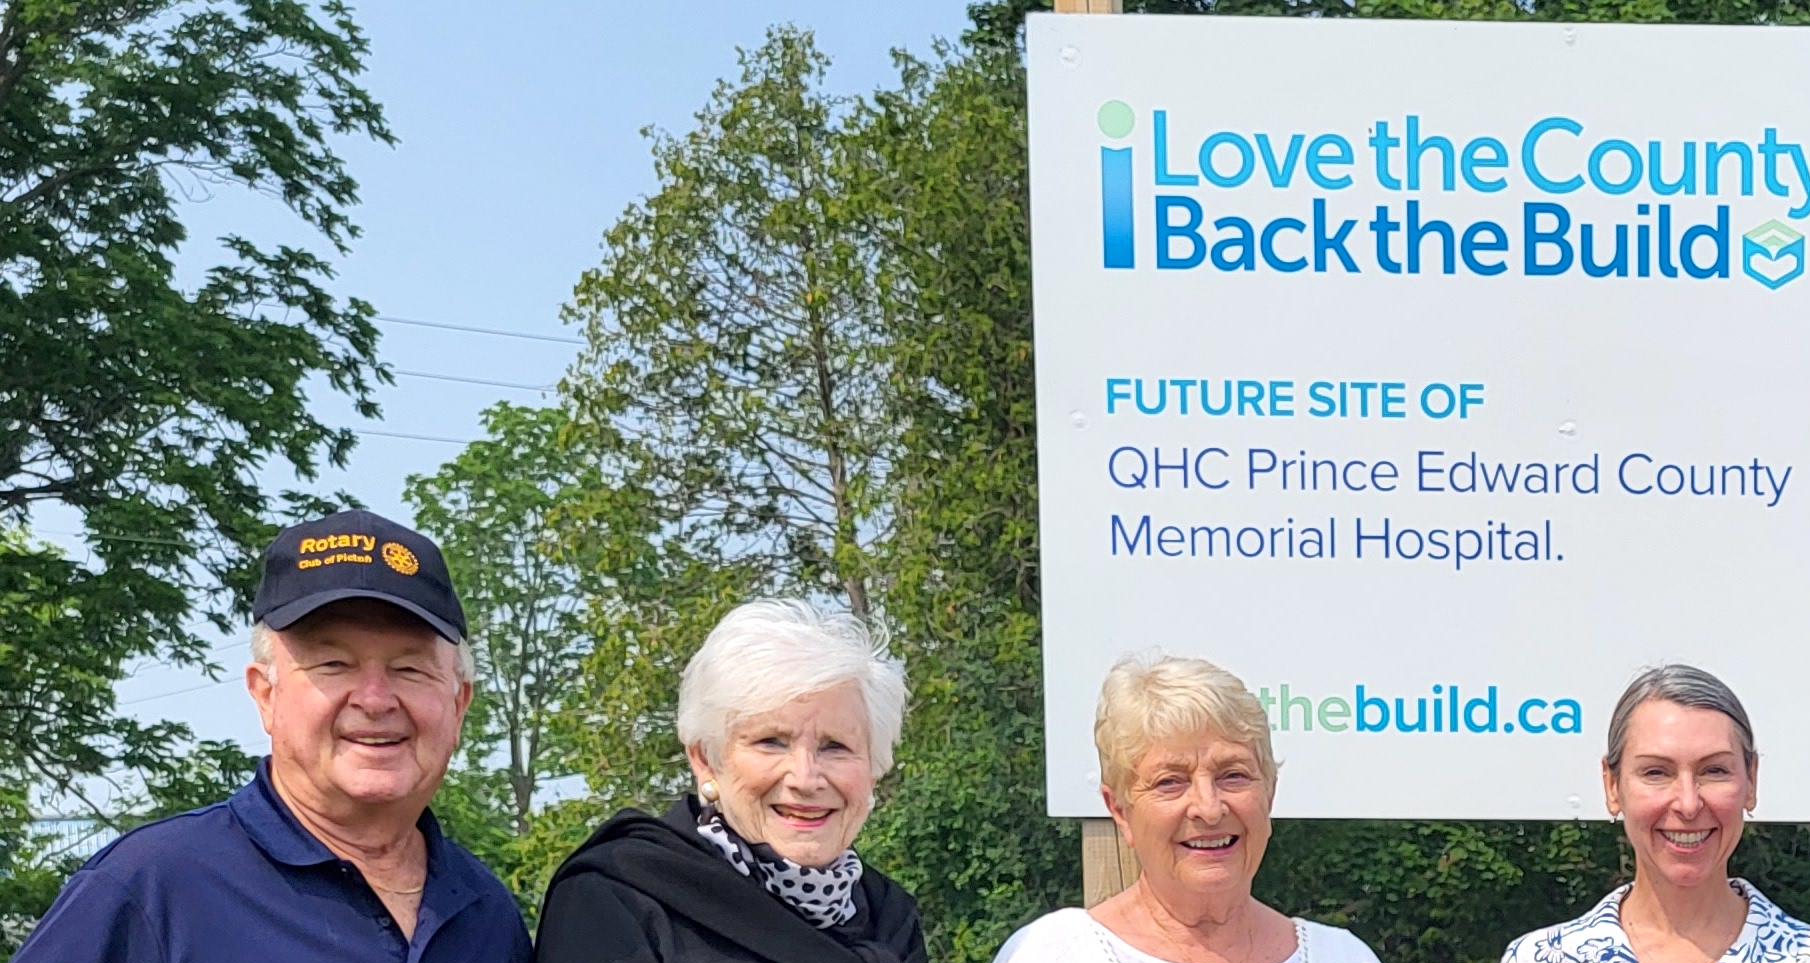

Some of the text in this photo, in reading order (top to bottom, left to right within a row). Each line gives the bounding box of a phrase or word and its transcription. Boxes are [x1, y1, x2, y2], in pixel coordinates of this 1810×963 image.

[1152, 109, 1354, 189] Love
[1370, 115, 1509, 194] the
[1155, 194, 1731, 280] Back the Build
[1105, 378, 1485, 420] FUTURE SITE OF
[1107, 446, 1793, 507] QHC Prince Edward County
[299, 553, 373, 569] Club of Picton
[300, 534, 376, 554] Rotary
[1110, 514, 1566, 571] Memorial Hospital.
[1258, 684, 1583, 735] thebuild.ca
